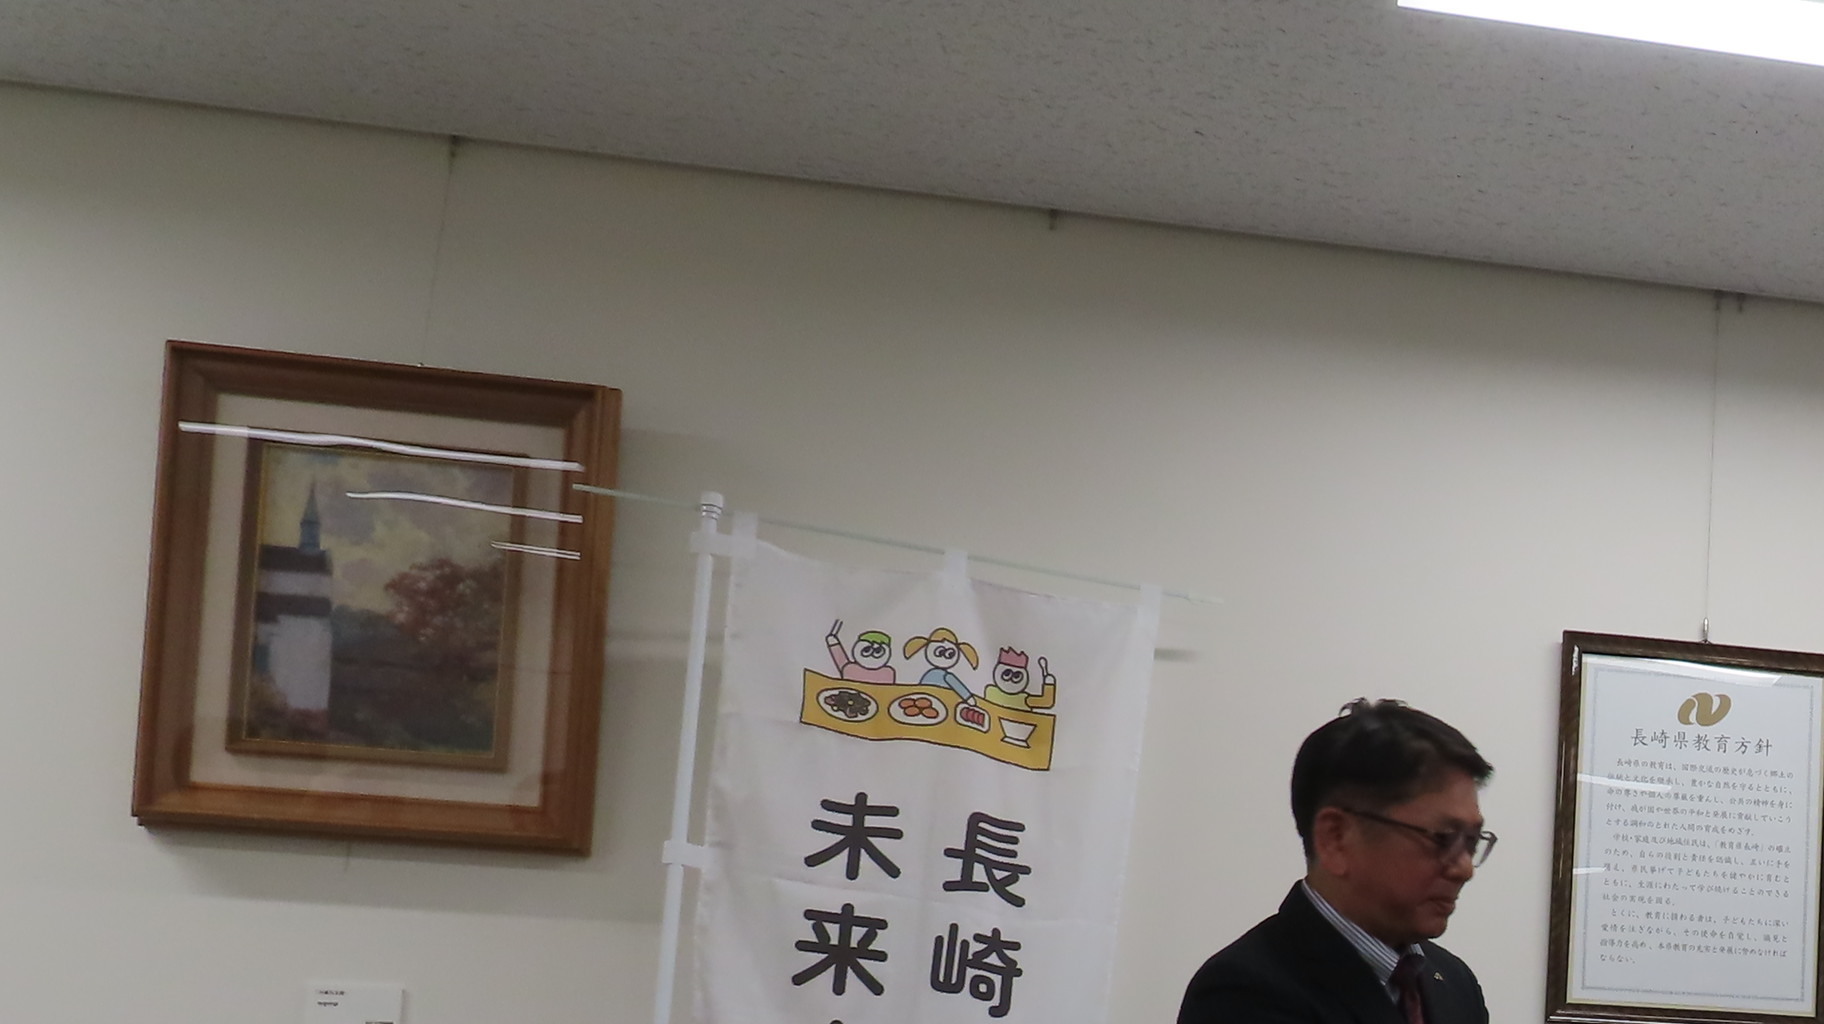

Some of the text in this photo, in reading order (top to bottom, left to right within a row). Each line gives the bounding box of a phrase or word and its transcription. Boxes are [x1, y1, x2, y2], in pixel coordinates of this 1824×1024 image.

[1630, 728, 1774, 757] 長崎県教育方針
